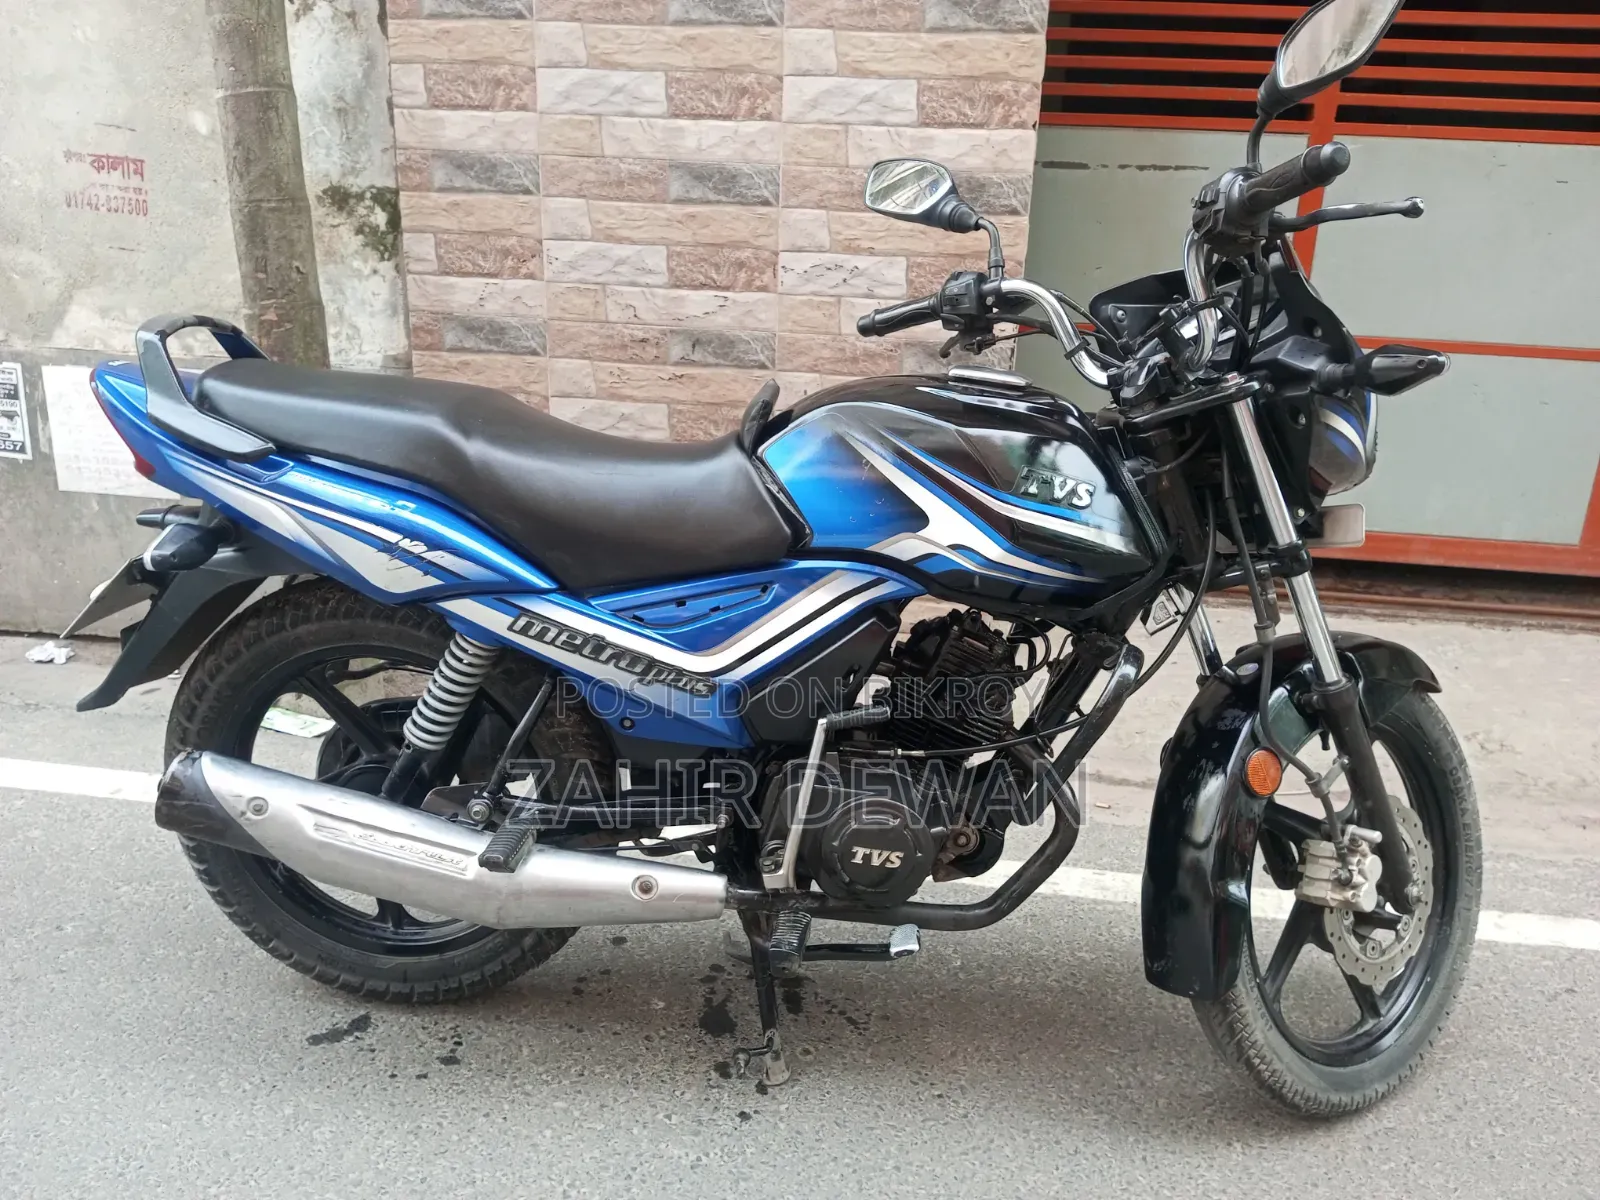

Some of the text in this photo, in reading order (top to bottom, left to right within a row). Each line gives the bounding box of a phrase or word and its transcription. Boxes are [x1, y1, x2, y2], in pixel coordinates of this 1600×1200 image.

[87, 153, 145, 181] কালাম
[1020, 466, 1095, 509] TVS
[509, 611, 653, 674] metro
[851, 846, 904, 868] TVS
